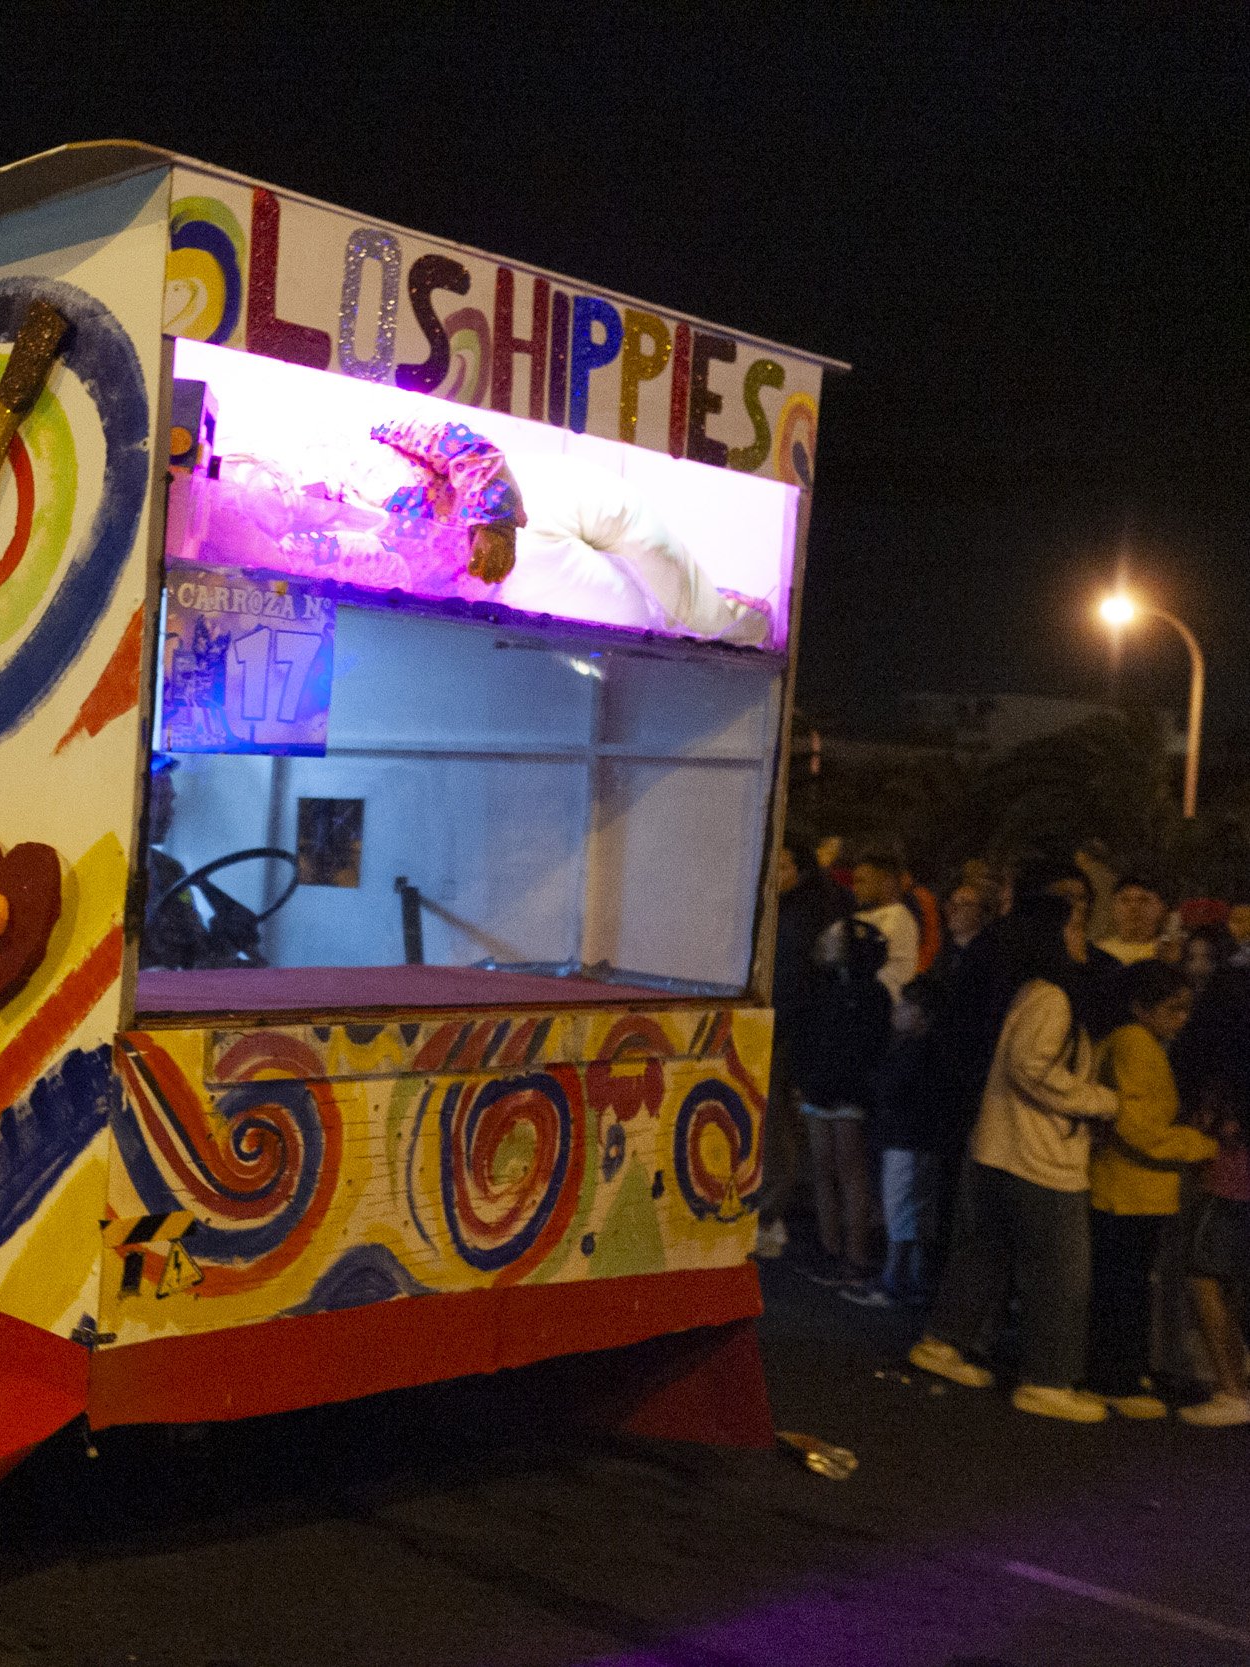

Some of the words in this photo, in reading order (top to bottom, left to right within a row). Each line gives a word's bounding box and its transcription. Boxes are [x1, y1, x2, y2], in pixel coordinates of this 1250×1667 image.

[249, 185, 471, 394] LOS
[490, 265, 786, 473] HIPPIES
[177, 582, 297, 621] CARROZA
[233, 624, 323, 724] 17
